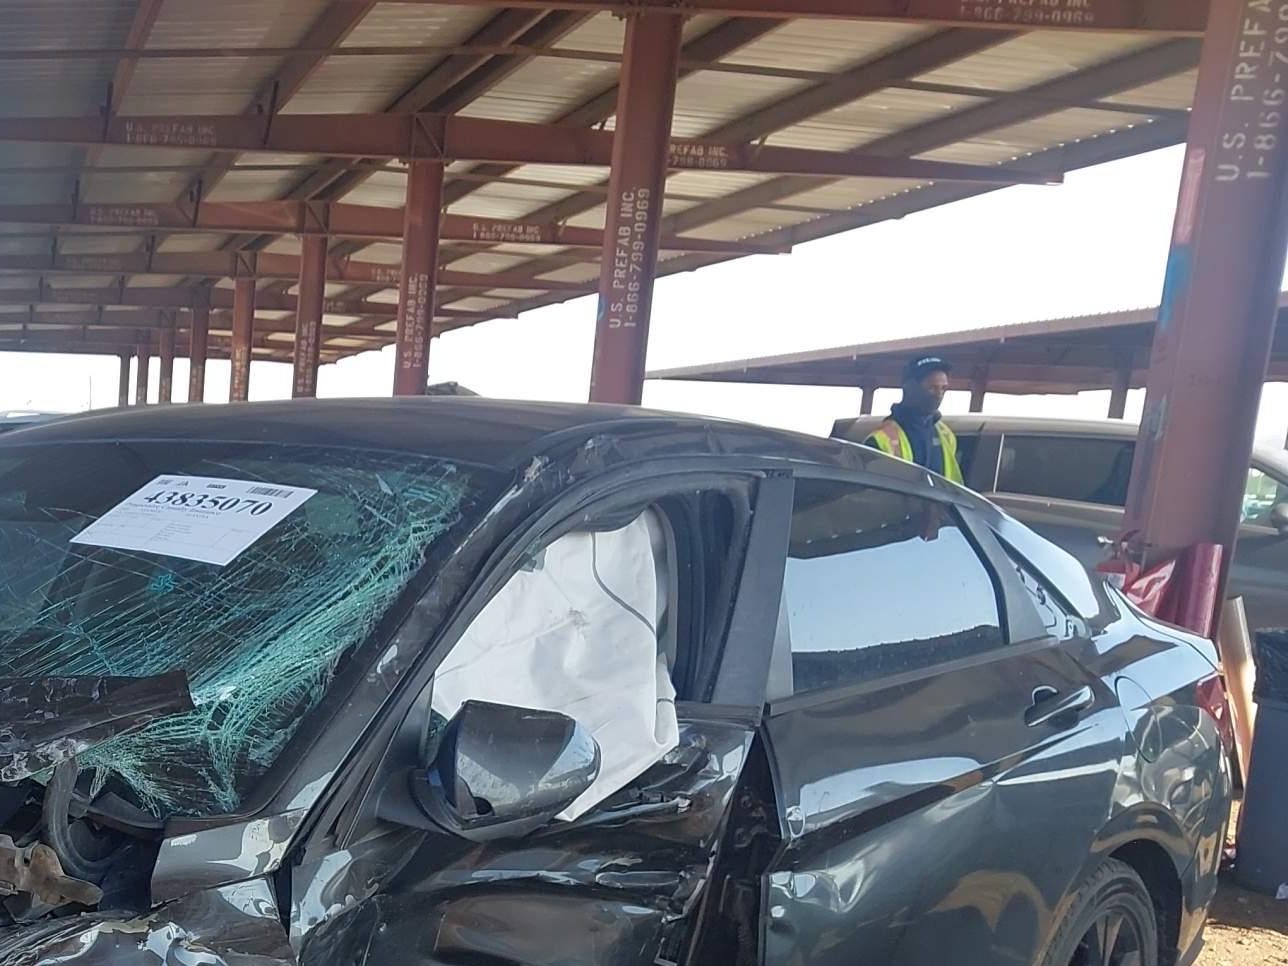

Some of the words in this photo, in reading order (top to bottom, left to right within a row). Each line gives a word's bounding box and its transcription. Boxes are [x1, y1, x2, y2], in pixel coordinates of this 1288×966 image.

[612, 226, 632, 289] PREFAB
[624, 187, 650, 328] 1-866-799-0969
[144, 489, 273, 517] 43835070
